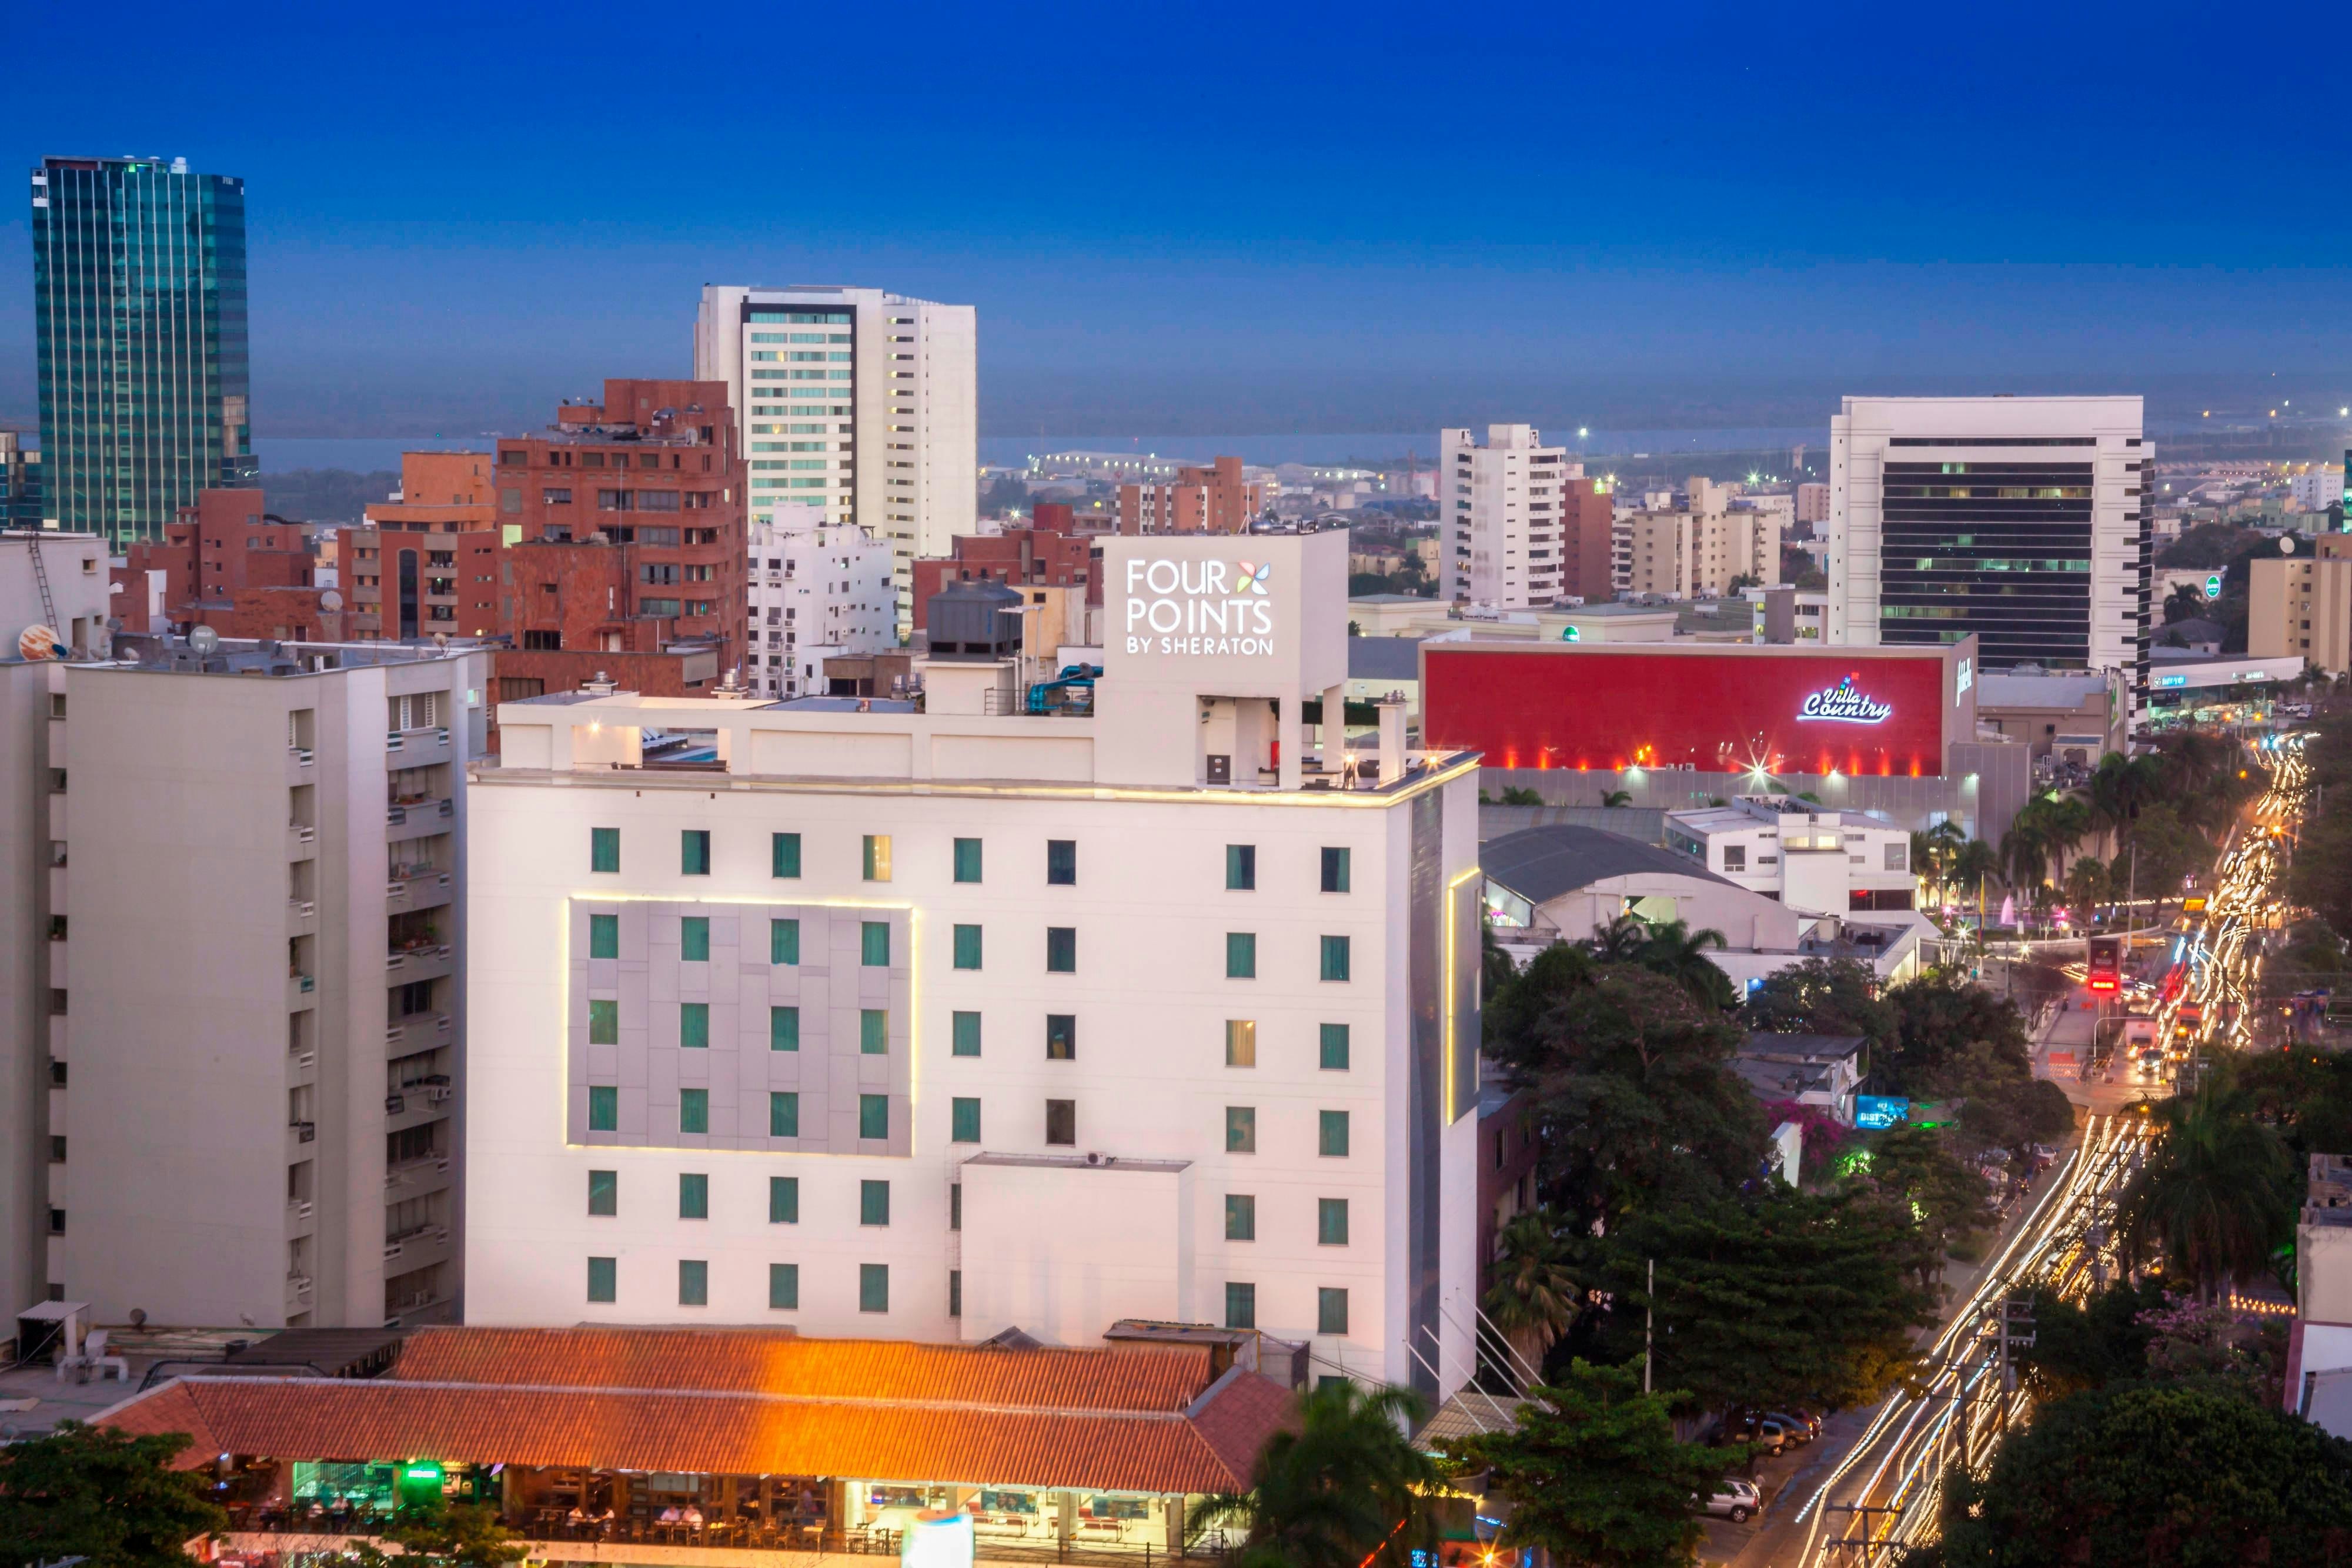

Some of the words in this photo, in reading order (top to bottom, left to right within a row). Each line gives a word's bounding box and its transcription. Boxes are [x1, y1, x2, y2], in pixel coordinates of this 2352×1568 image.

[1127, 559, 1230, 594] FOUR
[1127, 598, 1272, 634] POINTS
[1127, 636, 1152, 654] BY
[1161, 637, 1273, 656] SHERATON
[1805, 692, 1892, 722] Country
[1823, 687, 1861, 704] Villa
